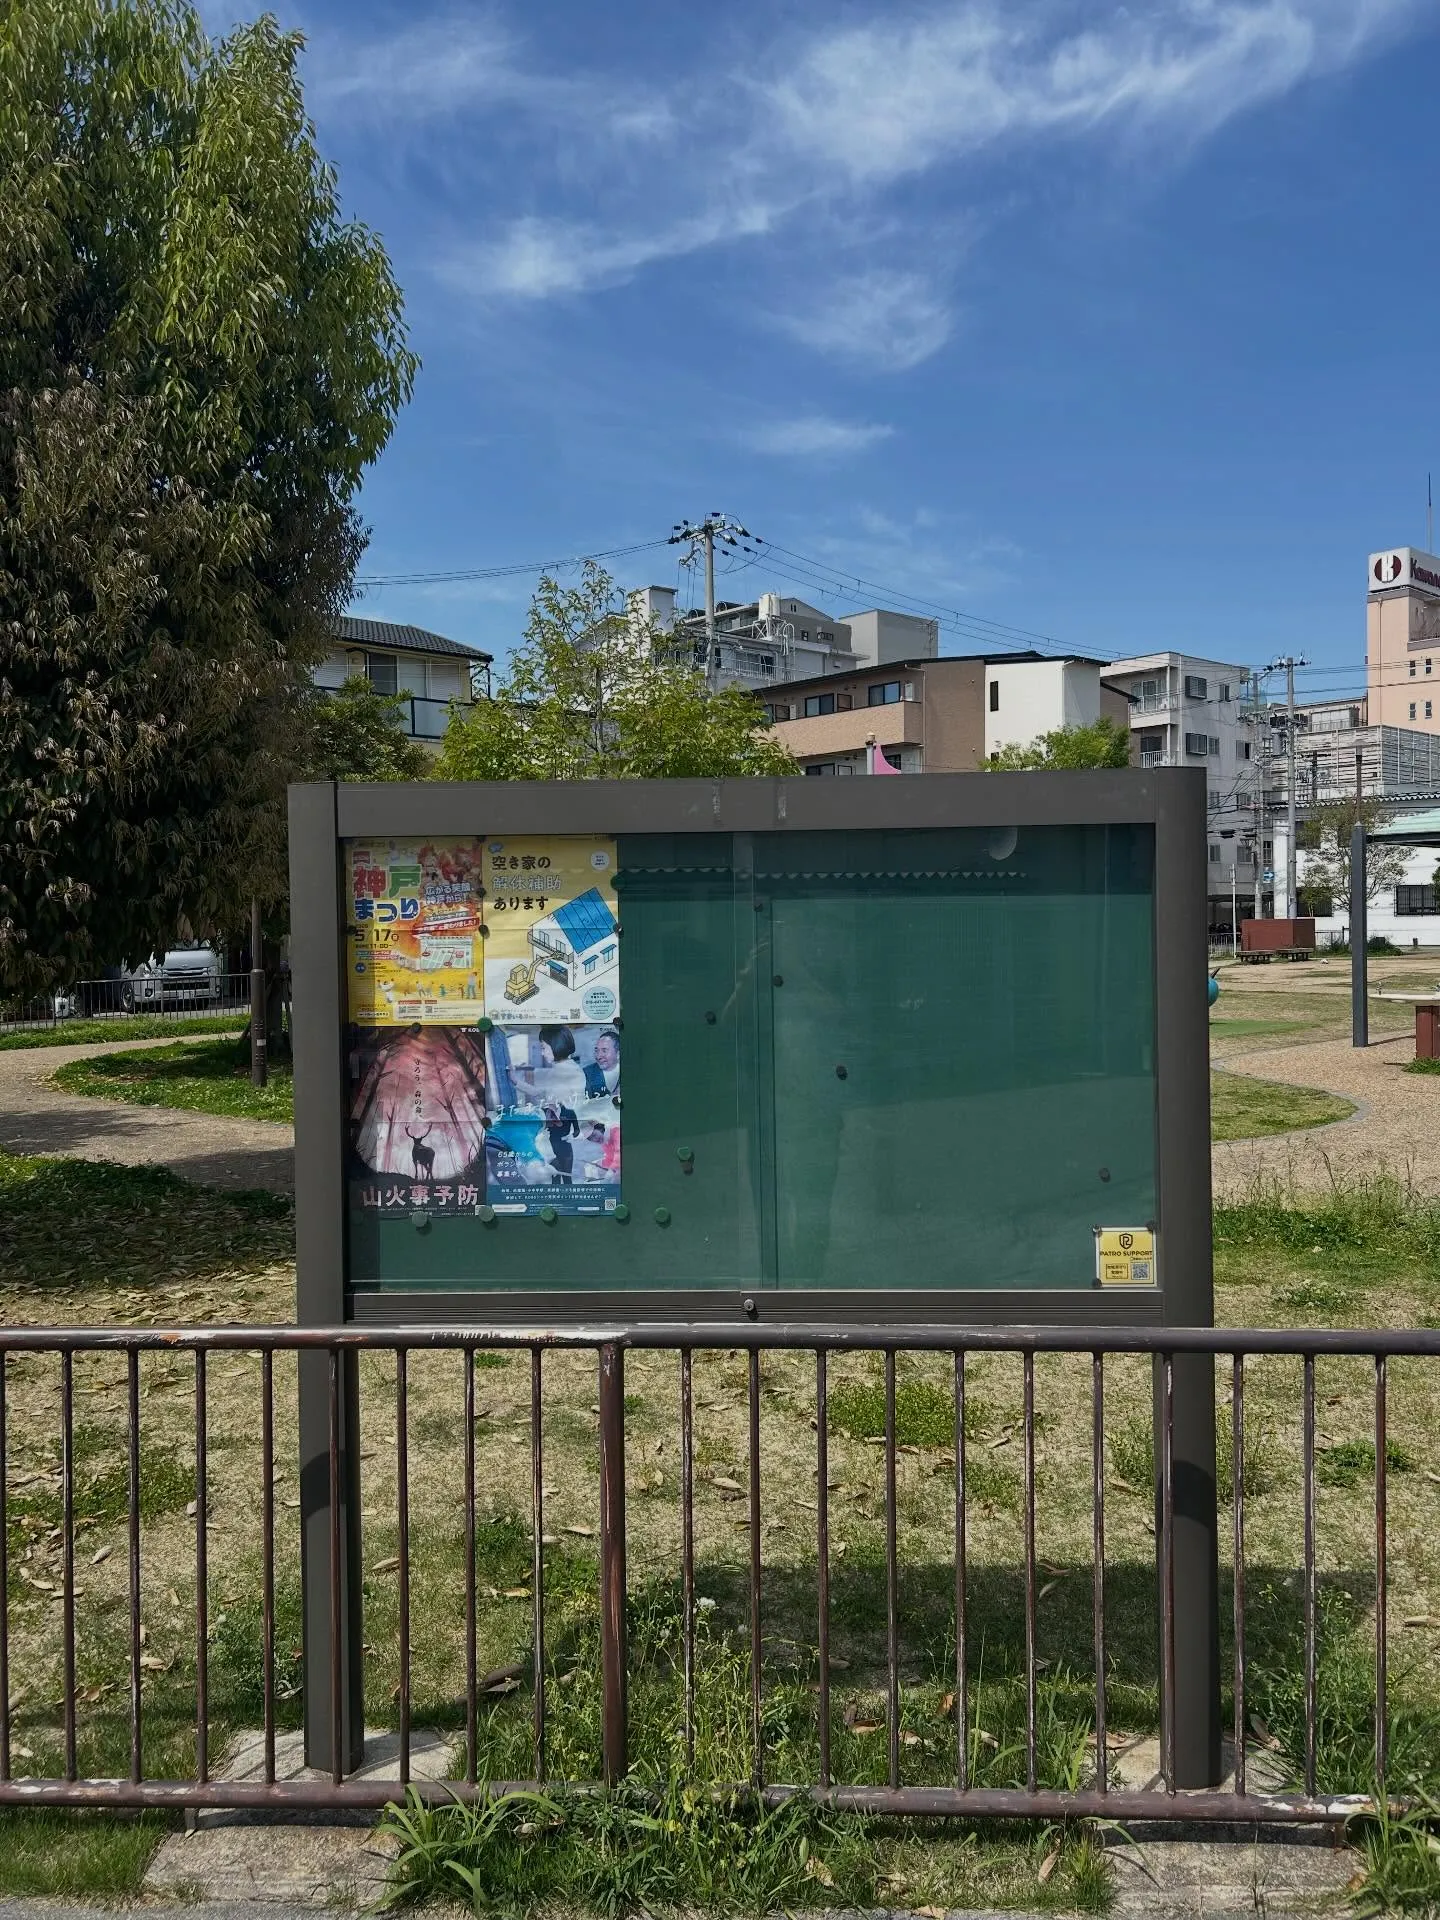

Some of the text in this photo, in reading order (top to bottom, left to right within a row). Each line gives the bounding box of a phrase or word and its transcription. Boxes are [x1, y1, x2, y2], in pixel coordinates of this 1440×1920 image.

[492, 856, 551, 870] 空き家の
[353, 864, 422, 899] 神戸
[354, 898, 420, 923] まつり
[494, 896, 548, 911] あります
[362, 1184, 479, 1207] 山火事予防
